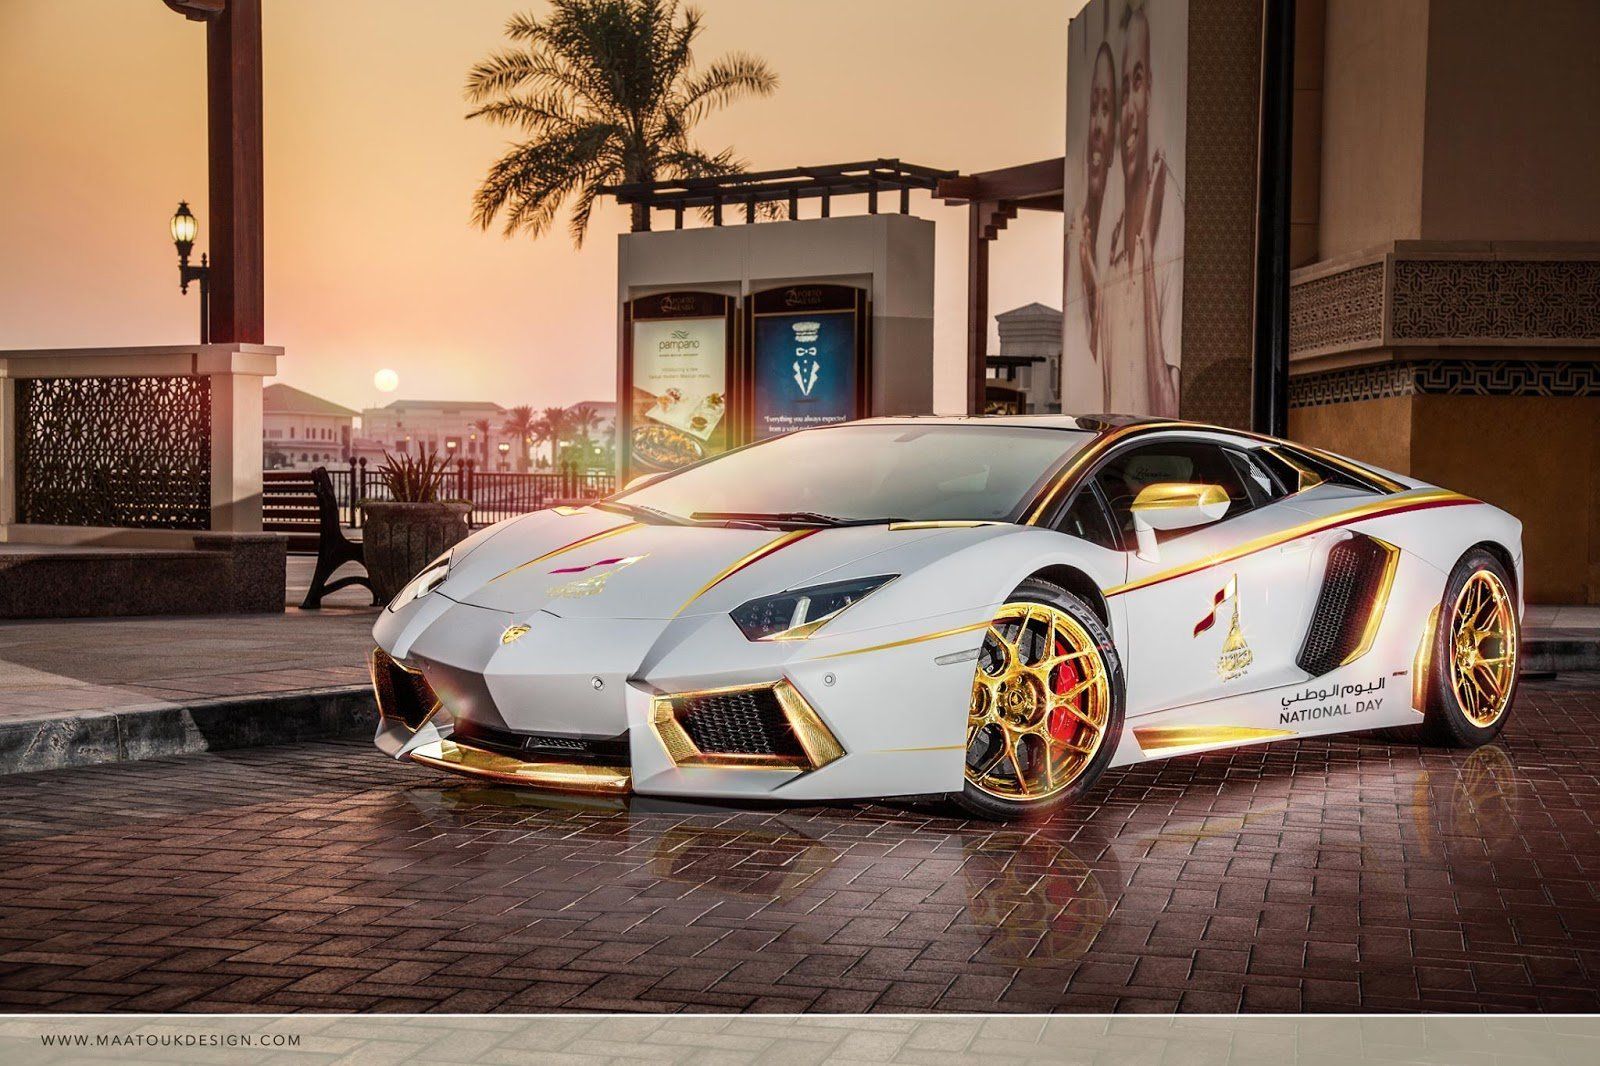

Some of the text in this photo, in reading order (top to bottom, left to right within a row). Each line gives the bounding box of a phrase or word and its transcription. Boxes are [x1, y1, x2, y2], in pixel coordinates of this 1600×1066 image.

[659, 339, 700, 352] pampano
[805, 415, 821, 423] always
[822, 415, 847, 423] expected
[1341, 677, 1385, 698] اليوم
[1280, 698, 1384, 724] NATIONAL DAY
